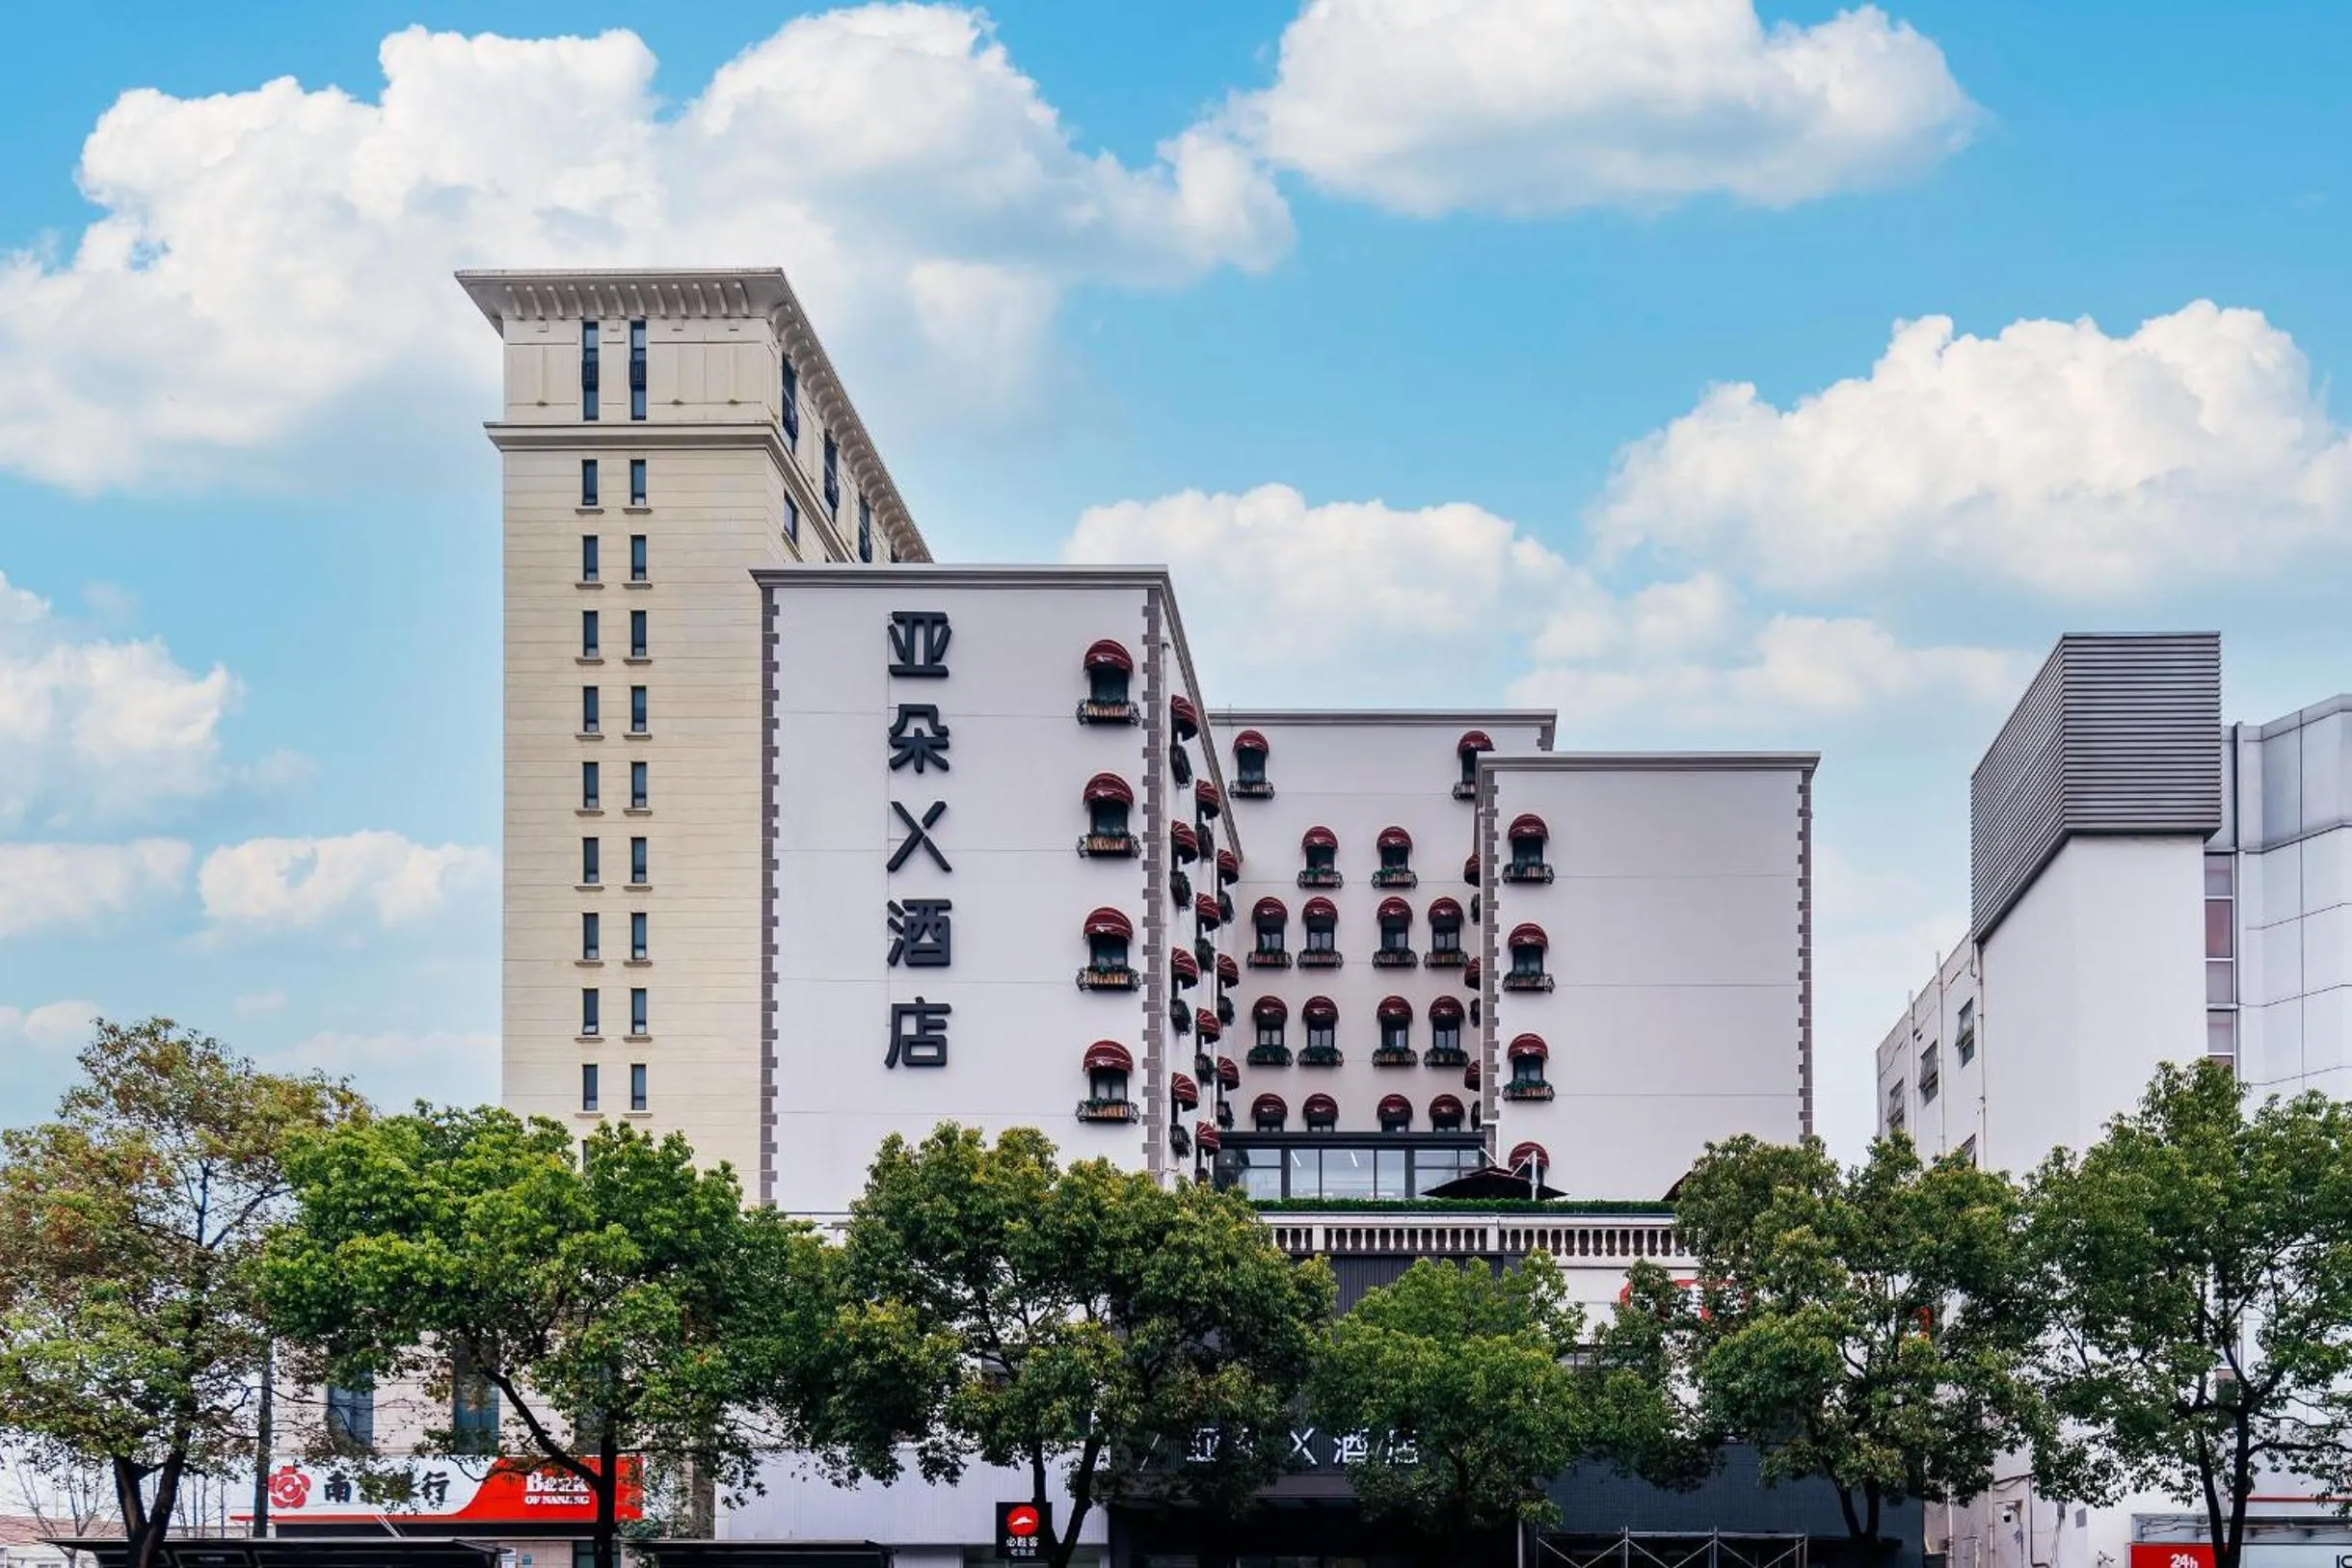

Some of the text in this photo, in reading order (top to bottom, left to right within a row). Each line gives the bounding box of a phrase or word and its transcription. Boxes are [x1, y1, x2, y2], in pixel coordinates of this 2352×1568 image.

[885, 611, 952, 1069] 亚朵X酒店
[1187, 1427, 1419, 1465] 亚X酒店
[325, 1471, 450, 1506] 南行
